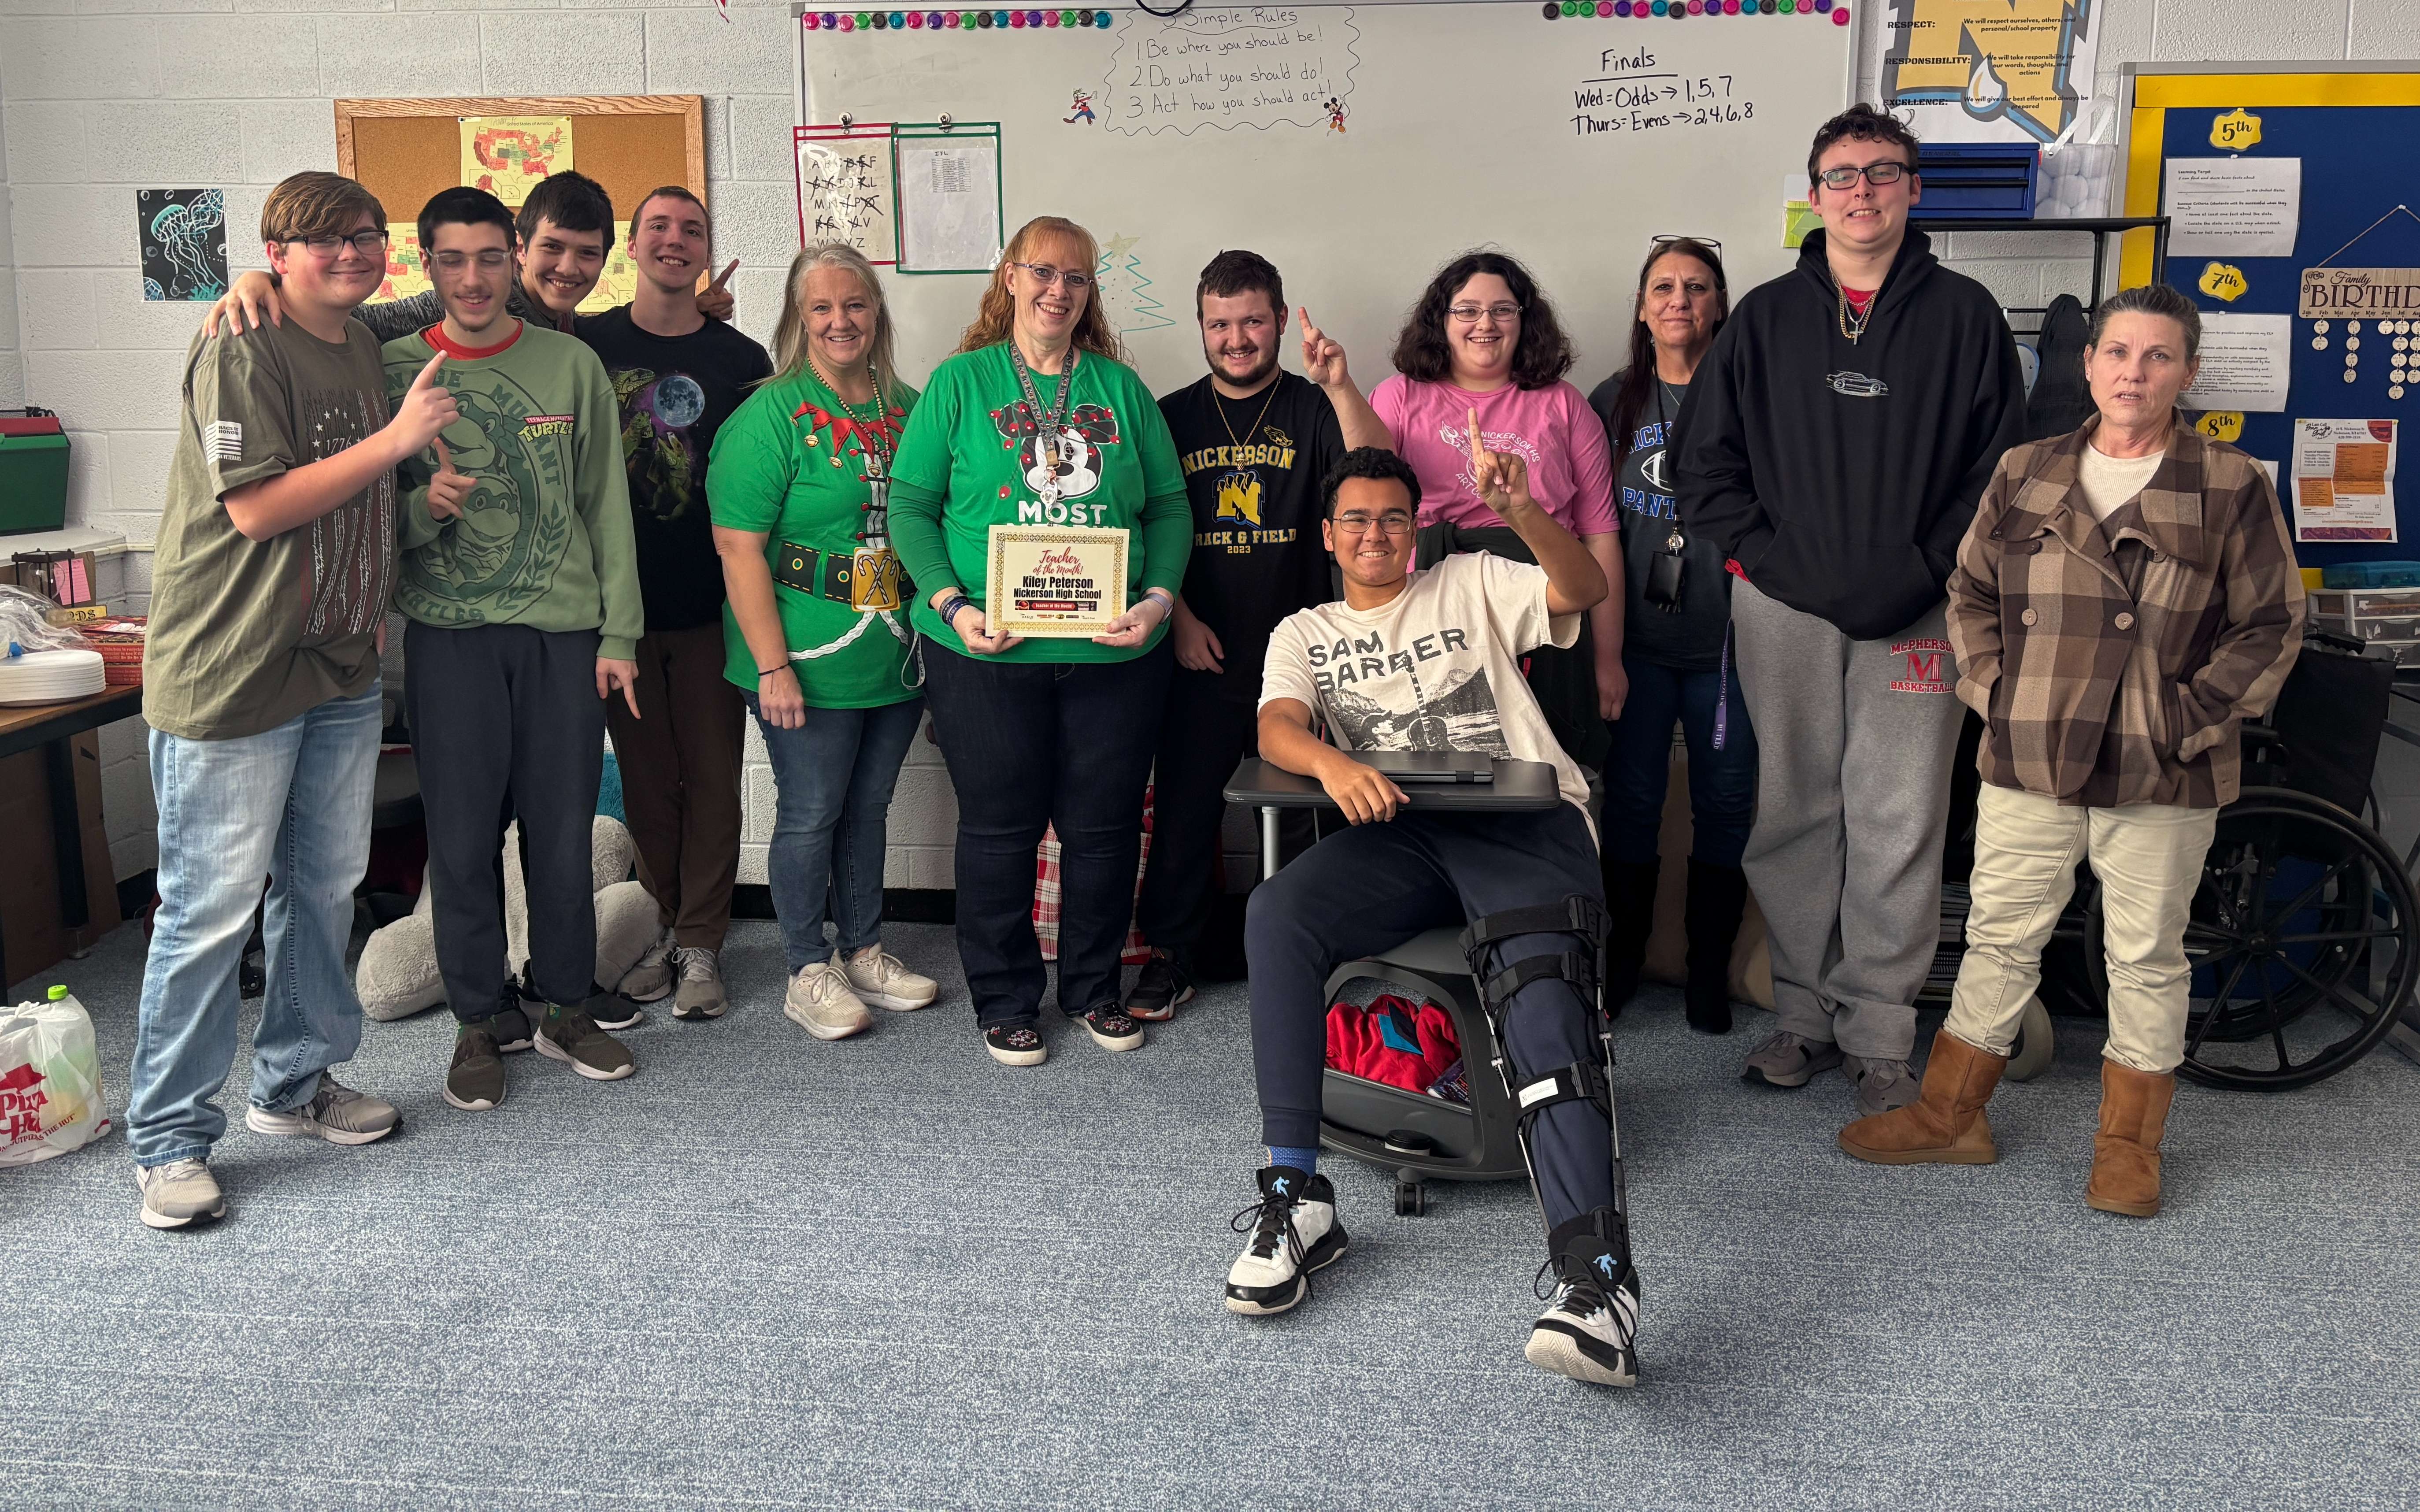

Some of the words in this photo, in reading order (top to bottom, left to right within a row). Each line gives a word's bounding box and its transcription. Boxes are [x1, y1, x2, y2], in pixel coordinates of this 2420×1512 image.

[1184, 9, 1242, 29] Simple
[1251, 7, 1298, 23] Rules
[1137, 42, 1144, 60] 1.
[1146, 38, 1168, 58] Be
[1177, 36, 1211, 54] where
[1218, 43, 1241, 56] you
[1245, 32, 1289, 49] should
[1297, 25, 1323, 42] be!
[1601, 46, 1656, 72] Finals
[1130, 65, 1146, 87] 2.
[1150, 65, 1170, 87] Do
[1178, 62, 1212, 84] what
[1219, 74, 1242, 91] you
[1250, 63, 1290, 81] should
[1301, 57, 1323, 80] do!
[1127, 96, 1145, 118] 3.
[1153, 92, 1179, 113] Act
[1190, 93, 1215, 111] how
[1223, 99, 1244, 115] you
[1252, 89, 1293, 106] should
[1302, 79, 1331, 102] act!
[2222, 121, 2252, 141] 5th
[2212, 272, 2239, 289] 7th
[2331, 271, 2372, 287] Family
[2208, 415, 2235, 436] 8th
[326, 435, 352, 454] 1776
[1481, 431, 1533, 449] NICKERSON
[1529, 449, 1540, 462] HS
[1455, 473, 1474, 489] ART
[1019, 500, 1107, 525] MOST
[1195, 531, 1233, 546] RACK
[1253, 528, 1297, 544] FIELD
[1039, 546, 1080, 563] Teacher
[1227, 545, 1251, 554] 2023
[1033, 564, 1042, 575] of
[1043, 562, 1055, 575] the
[1056, 563, 1083, 576] Month!
[1023, 576, 1047, 589] Kiley
[1049, 577, 1093, 589] Peterson
[1014, 588, 1053, 599] Nickerson
[1056, 589, 1073, 599] High
[1075, 589, 1101, 599] School
[1308, 630, 1384, 667] SAM
[1890, 638, 1955, 656] McPHERSO
[1313, 628, 1468, 693] BARBER
[1904, 653, 1946, 682] M
[1890, 680, 1954, 693] BASKETBALL
[43, 1124, 59, 1137] THE
[59, 1114, 75, 1128] HUT
